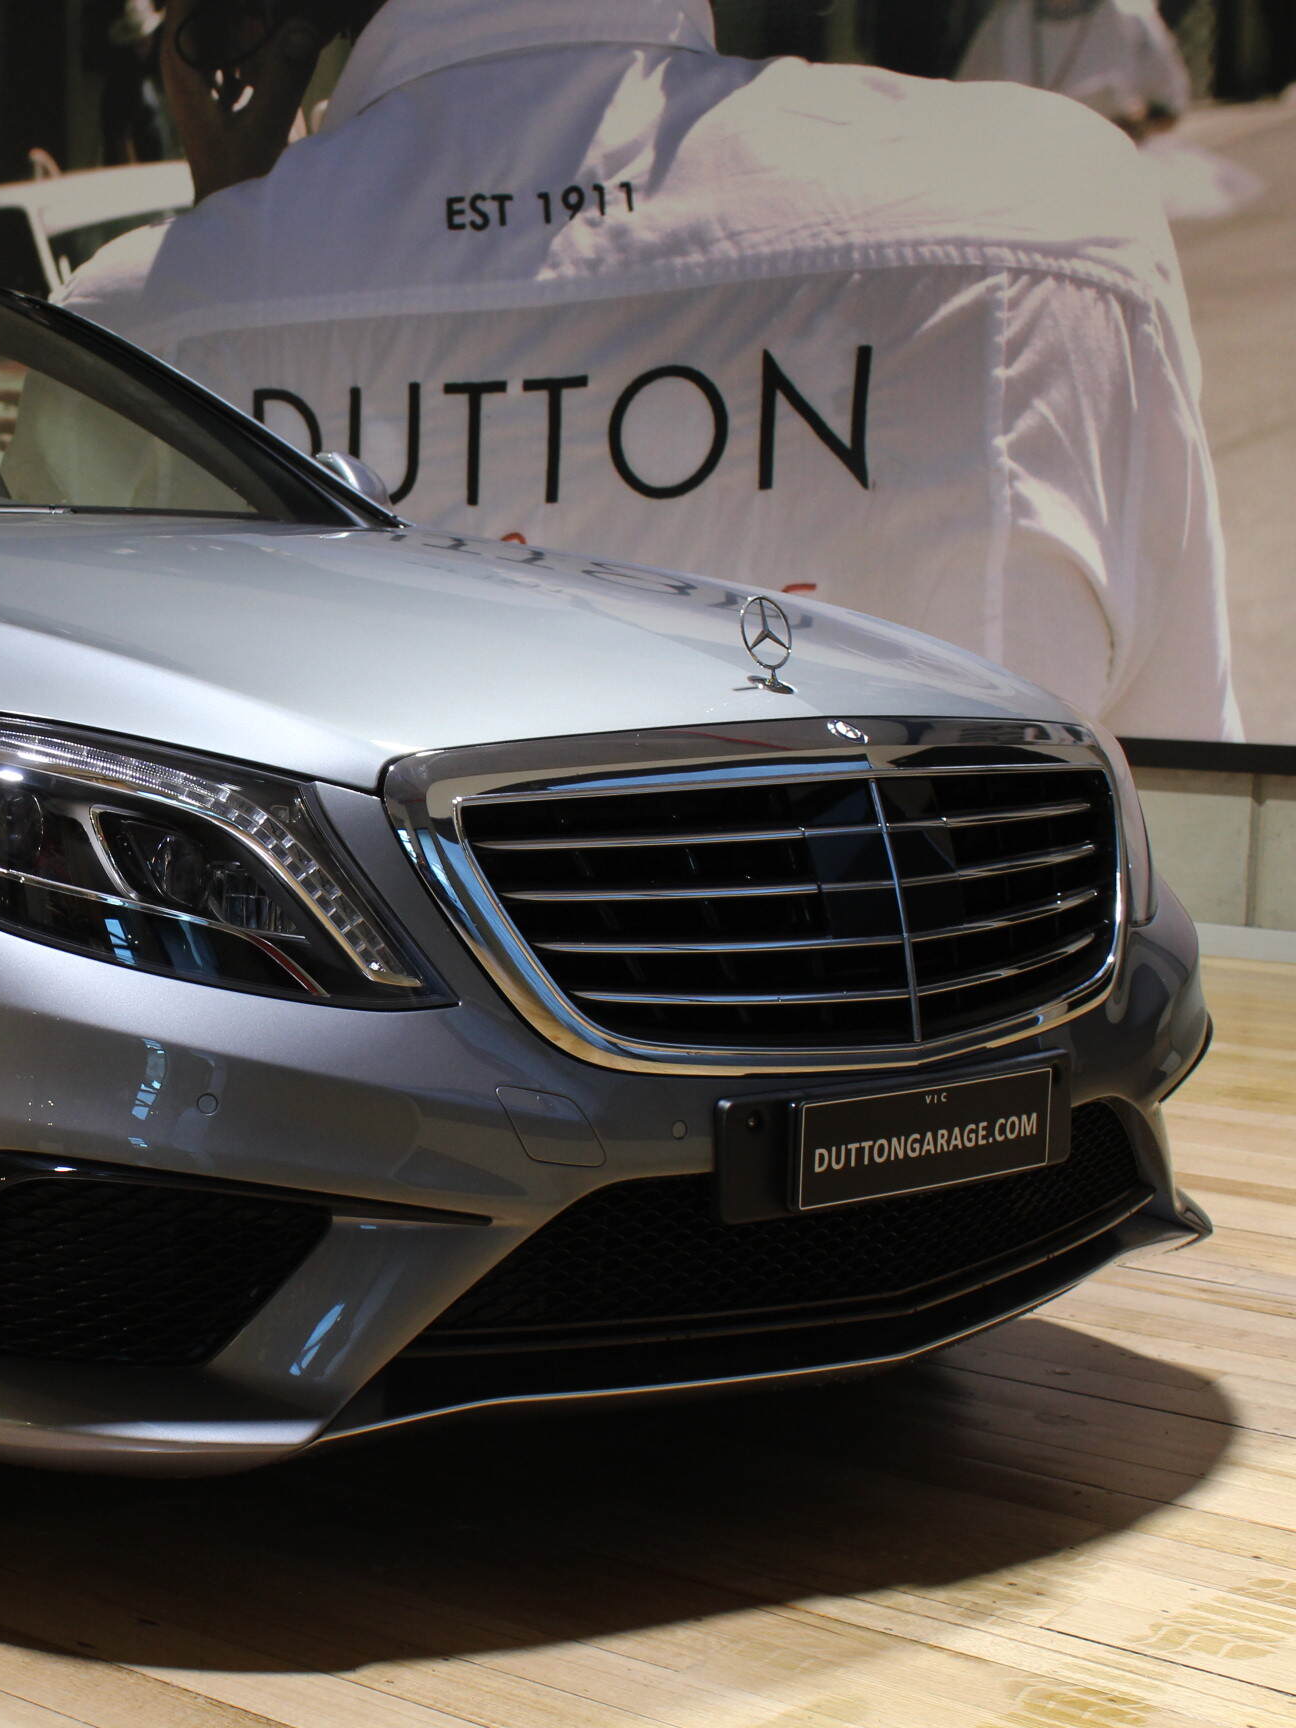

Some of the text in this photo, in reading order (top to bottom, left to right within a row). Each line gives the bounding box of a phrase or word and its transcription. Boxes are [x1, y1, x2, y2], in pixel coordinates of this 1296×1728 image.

[446, 180, 636, 231] EST 1911
[925, 1093, 948, 1104] VIC
[814, 1112, 1037, 1173] DUTTONGARAGE.COM
